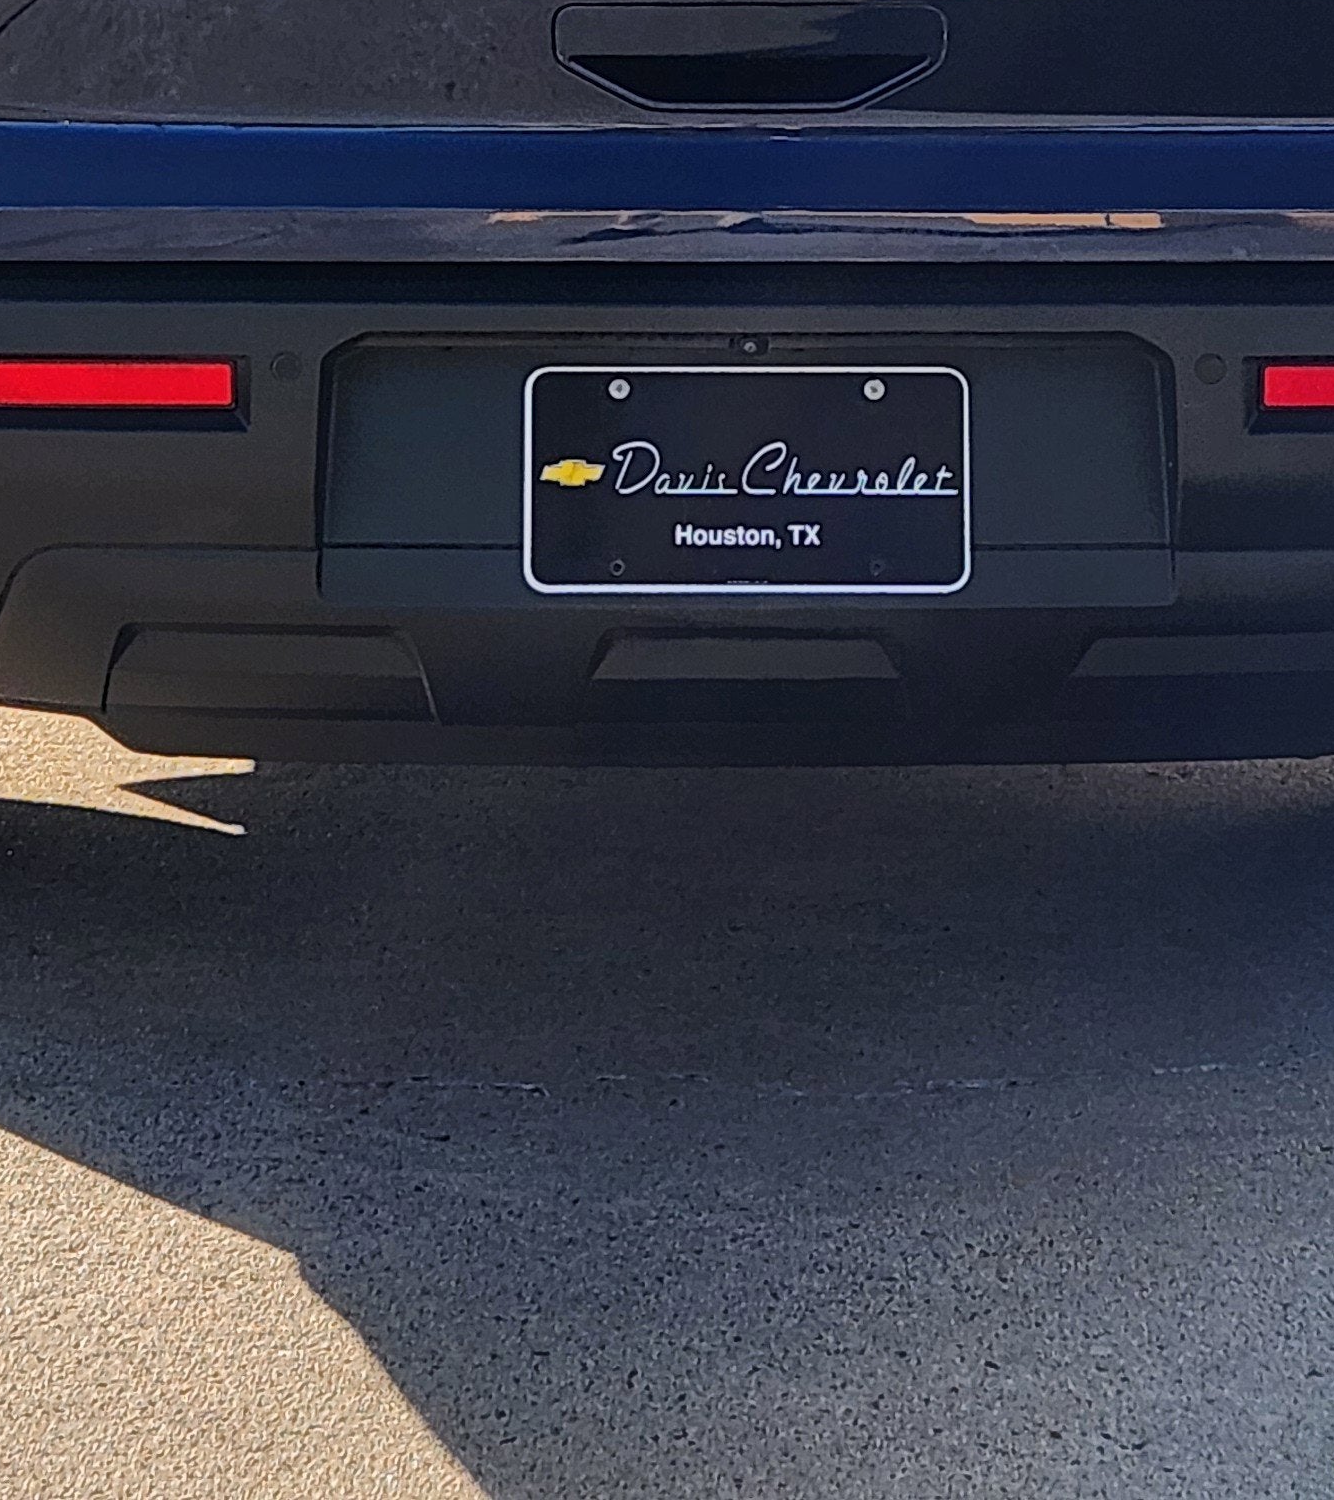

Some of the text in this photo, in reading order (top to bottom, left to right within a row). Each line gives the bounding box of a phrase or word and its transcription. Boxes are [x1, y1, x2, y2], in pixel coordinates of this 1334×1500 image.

[612, 440, 959, 495] Davis Chevrolet
[674, 523, 821, 549] Houston, TX
